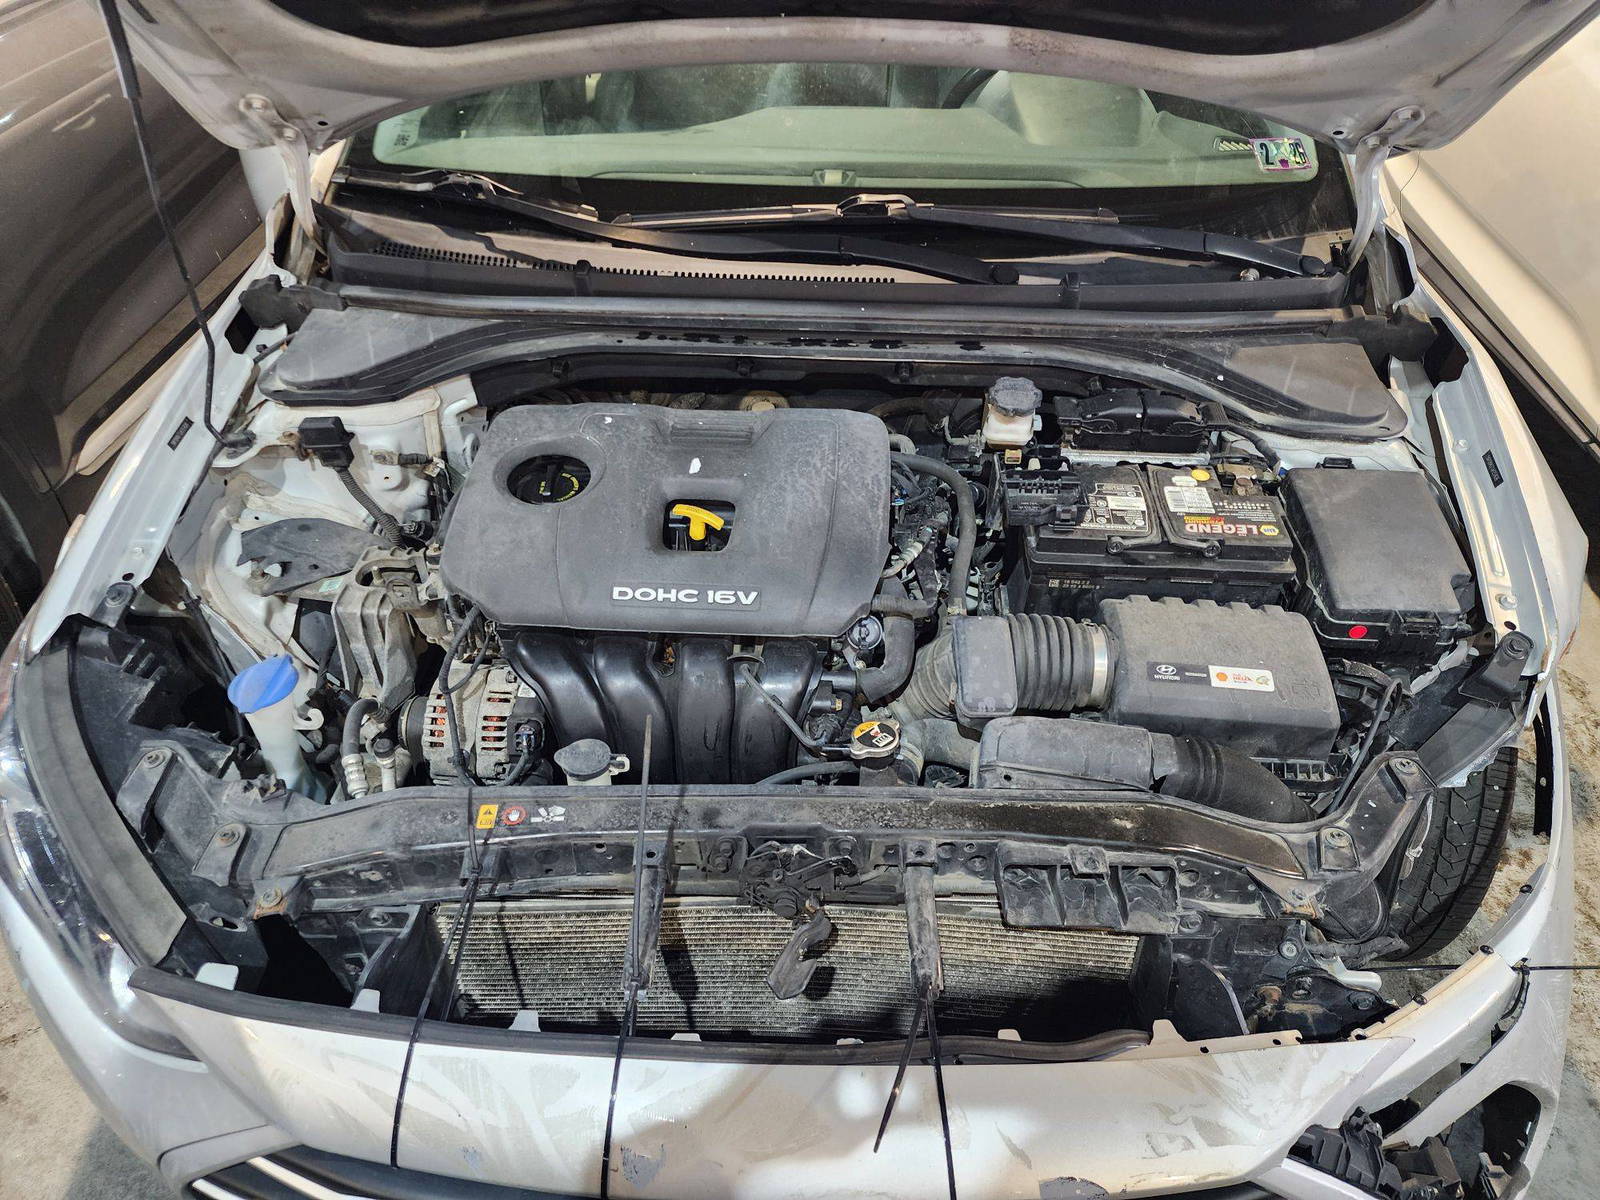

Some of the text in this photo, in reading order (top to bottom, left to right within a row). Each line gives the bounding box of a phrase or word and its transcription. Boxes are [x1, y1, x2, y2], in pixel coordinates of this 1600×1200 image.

[1260, 142, 1306, 165] 2 26
[1184, 523, 1259, 535] LEGEND
[612, 586, 759, 605] DOHC 16V
